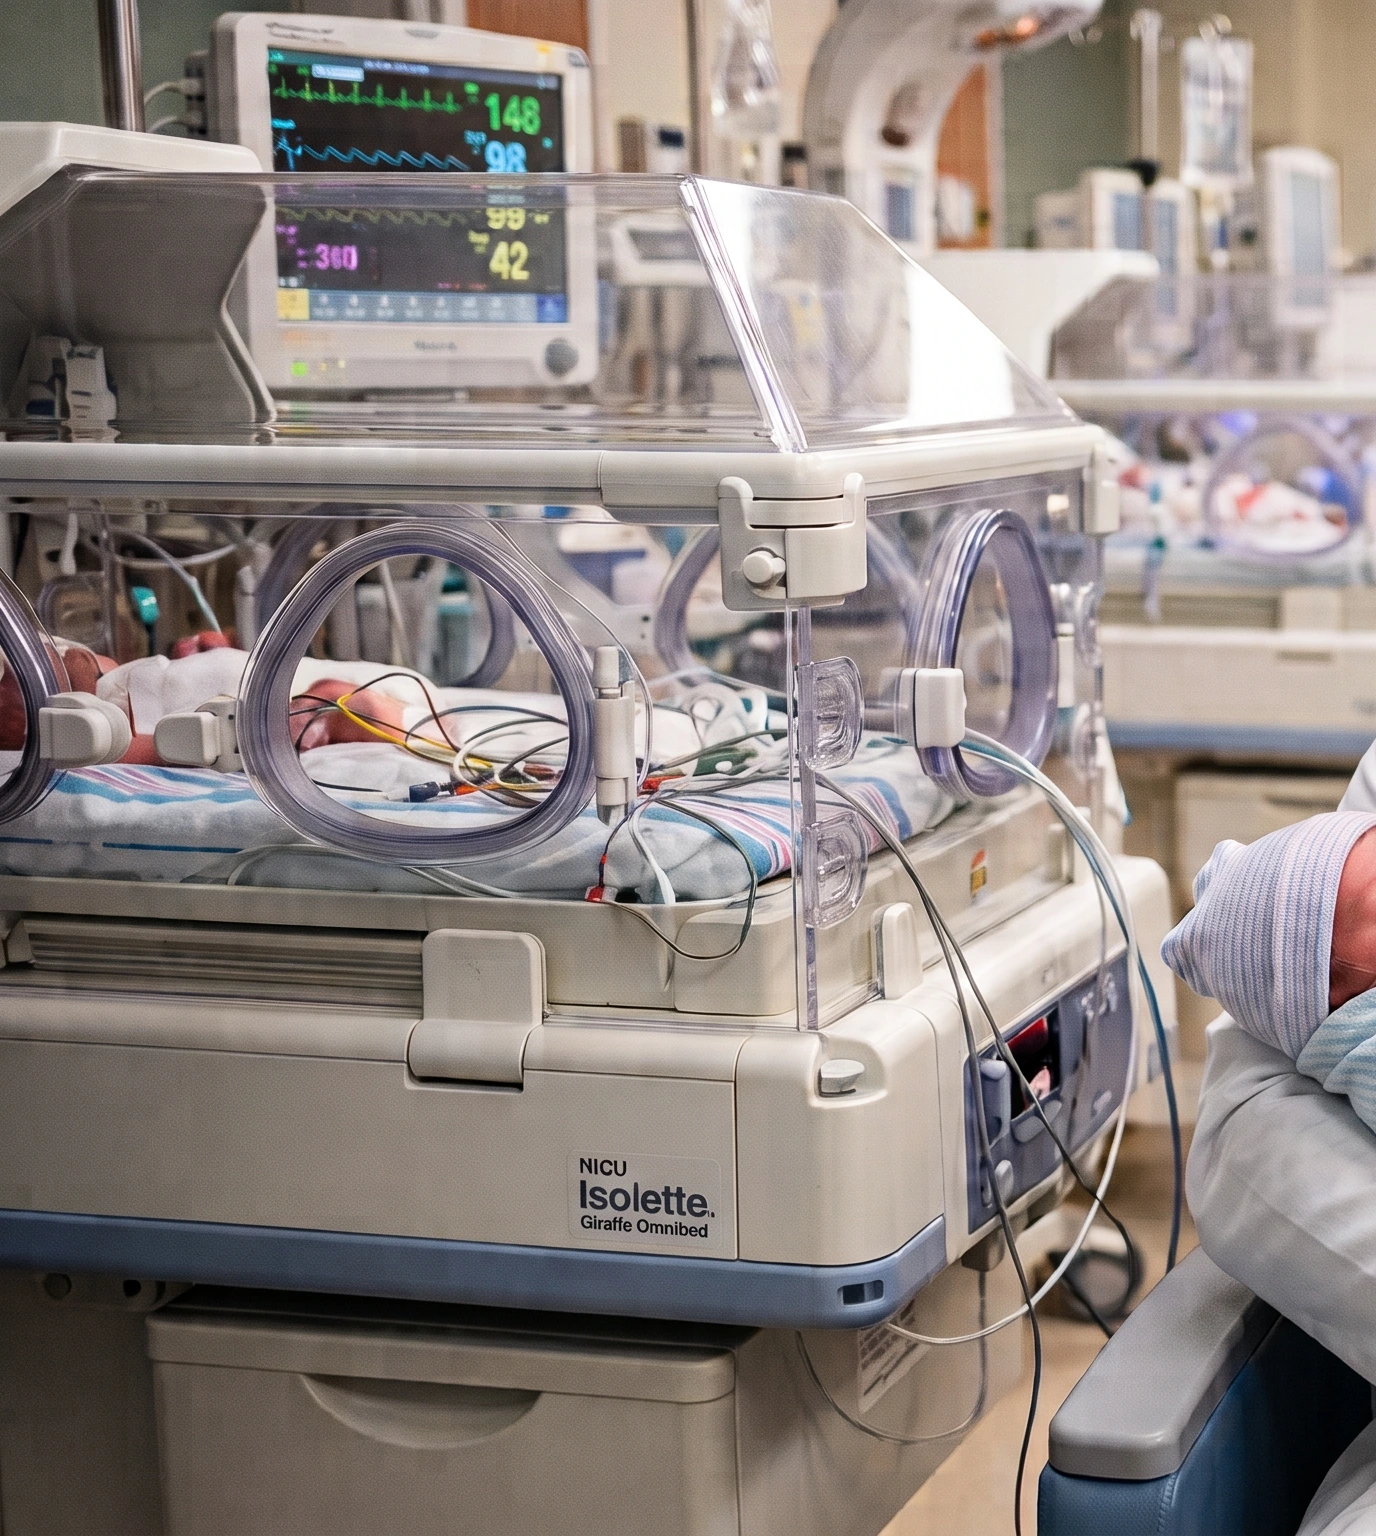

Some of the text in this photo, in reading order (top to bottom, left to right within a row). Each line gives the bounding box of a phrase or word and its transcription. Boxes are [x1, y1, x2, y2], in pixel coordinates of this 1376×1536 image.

[485, 92, 540, 135] 148
[485, 140, 527, 172] 98
[489, 241, 530, 280] 42
[580, 1158, 627, 1177] NICU
[581, 1215, 709, 1238] Giraffe Omnibed
